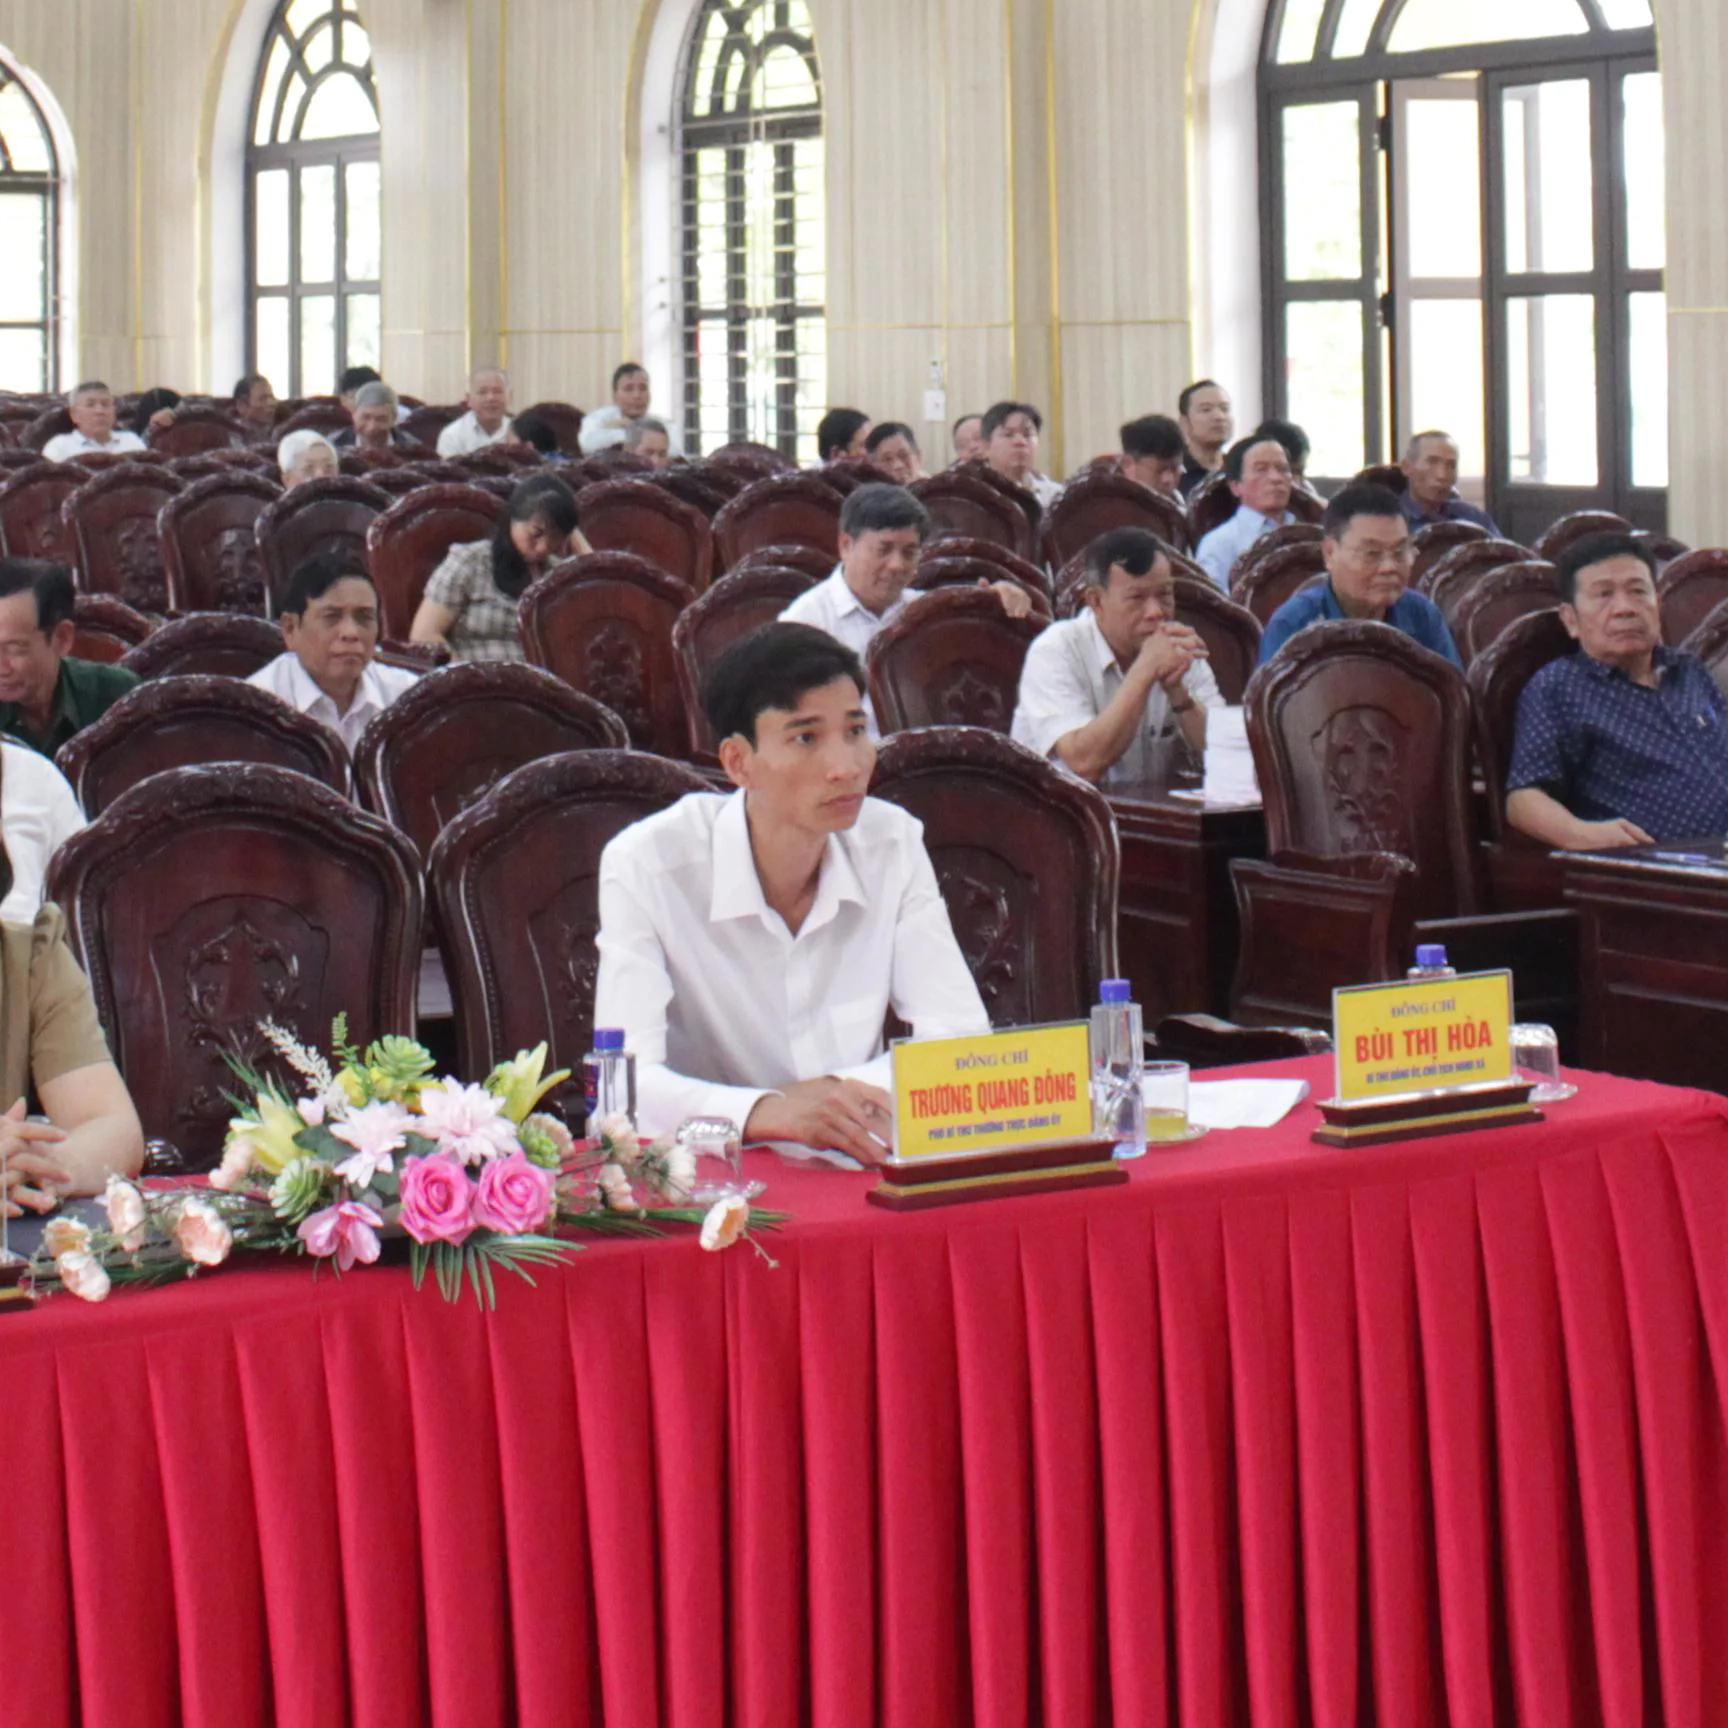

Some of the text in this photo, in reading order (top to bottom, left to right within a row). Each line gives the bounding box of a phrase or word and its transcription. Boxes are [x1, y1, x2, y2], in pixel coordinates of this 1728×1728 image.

[955, 1049, 1029, 1070] ĐỒNG CHÍ
[1356, 1026, 1393, 1063] BÙI
[1402, 1026, 1437, 1061] THỊ
[977, 1076, 1029, 1114] QUANG
